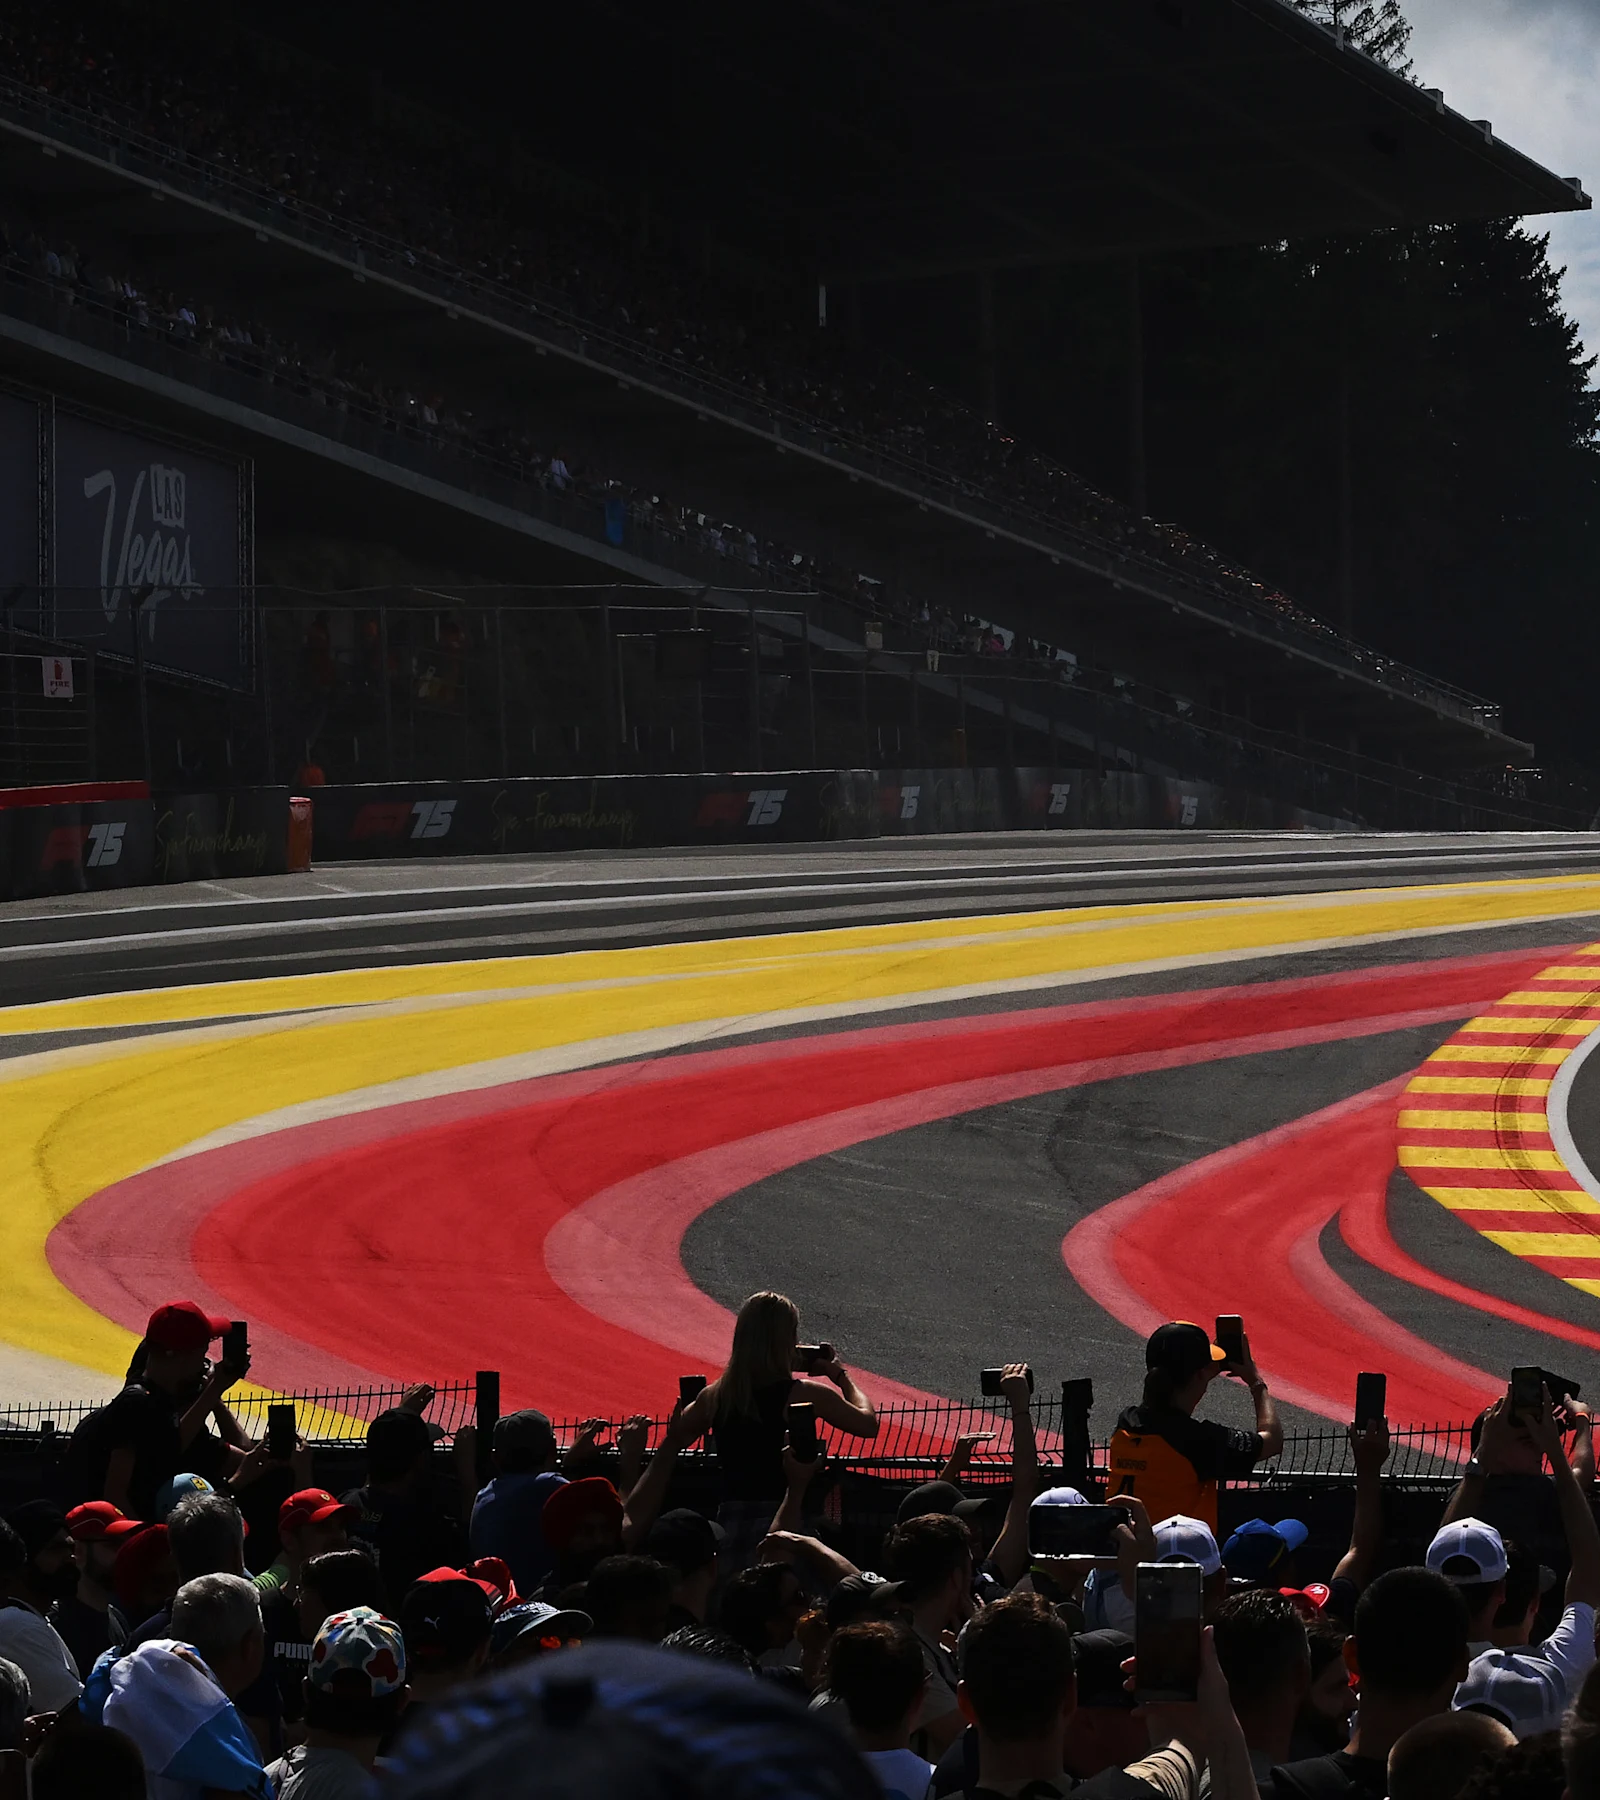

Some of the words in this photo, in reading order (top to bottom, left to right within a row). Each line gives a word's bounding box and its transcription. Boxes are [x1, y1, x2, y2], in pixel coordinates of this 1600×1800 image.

[154, 469, 183, 520] LAS
[84, 469, 206, 642] Vegas
[50, 680, 70, 688] FIRE
[747, 789, 788, 826] 75
[900, 786, 920, 819] 75
[1048, 784, 1070, 814] 75
[410, 800, 457, 838] 75
[86, 822, 127, 867] 75
[1116, 1458, 1147, 1471] NORRIS
[274, 1641, 313, 1661] PUM
